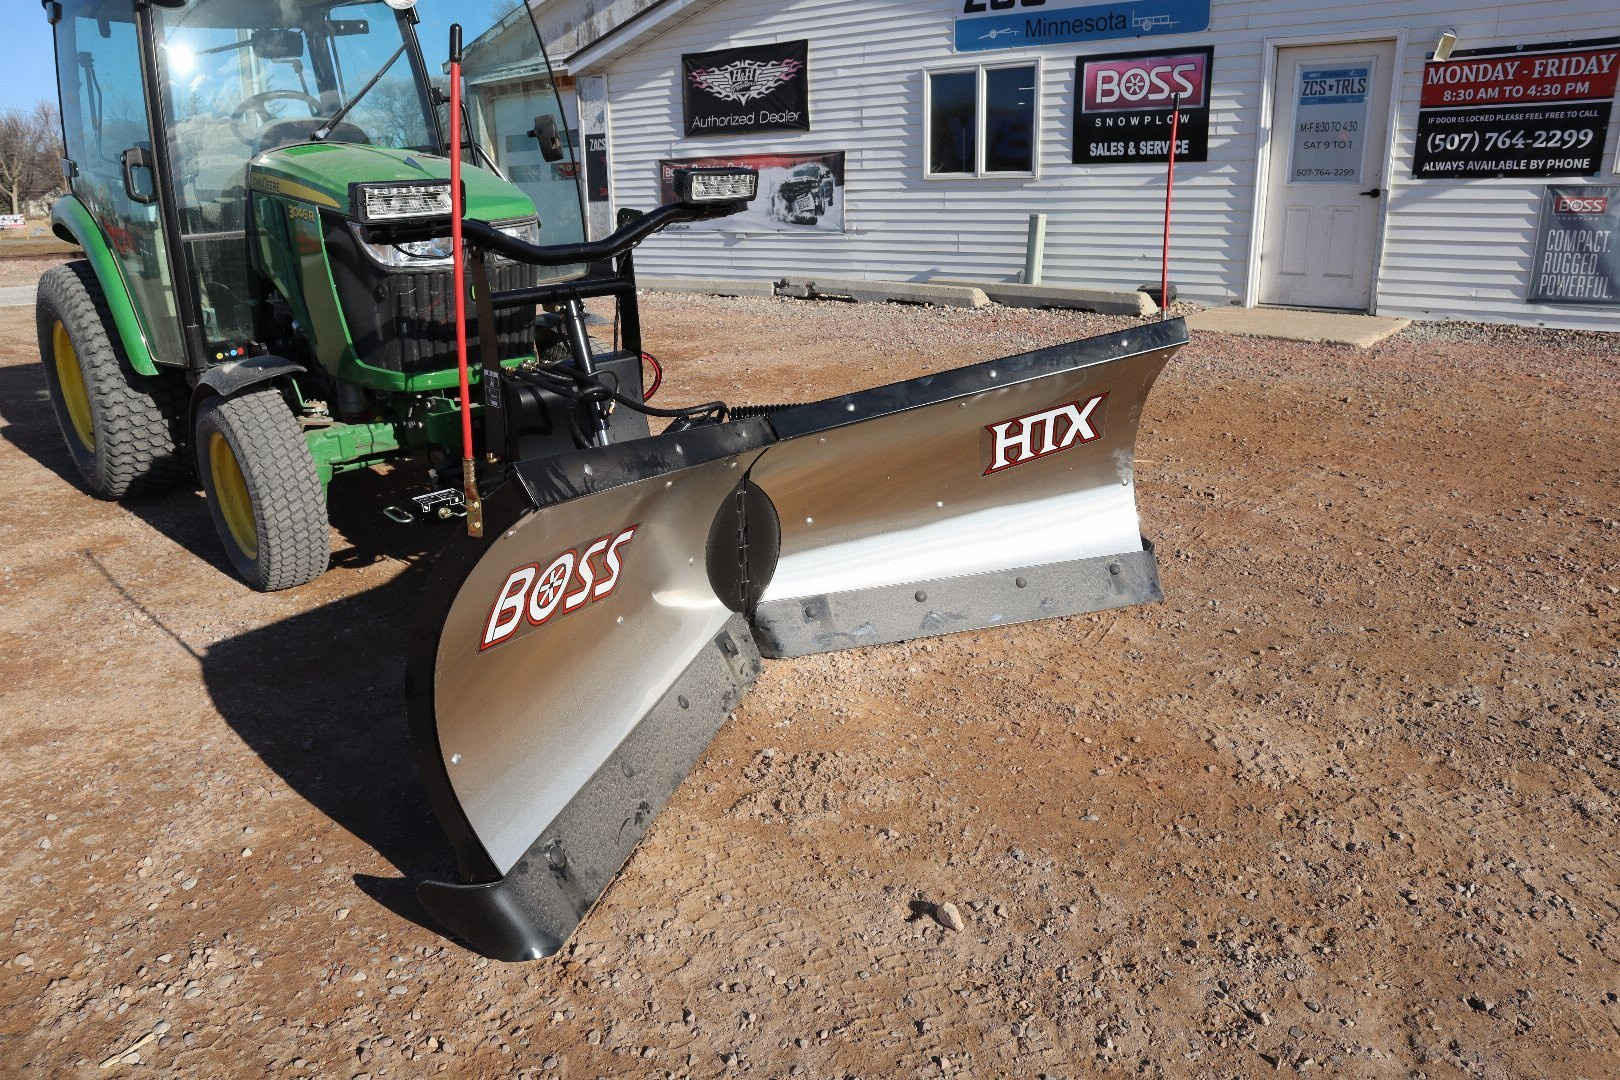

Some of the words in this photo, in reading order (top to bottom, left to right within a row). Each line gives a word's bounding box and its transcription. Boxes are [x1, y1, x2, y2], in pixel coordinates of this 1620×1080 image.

[1025, 12, 1127, 38] Minnesota
[1426, 61, 1520, 85] MONDAY
[1532, 53, 1617, 79] FRIDAY
[1095, 64, 1196, 103] BOSS
[1302, 80, 1327, 96] ZCS
[1335, 78, 1366, 95] TRLS
[1443, 89, 1474, 101] 8:30
[1476, 87, 1500, 99] AM
[1503, 85, 1524, 98] TO
[1527, 83, 1561, 97] 4:30
[1564, 81, 1590, 94] PM
[692, 112, 755, 129] Authorized
[759, 110, 801, 123] Dealer
[1466, 114, 1495, 122] LOCKED
[1496, 113, 1524, 121] PLEASE
[1525, 112, 1544, 120] FEEL
[1545, 111, 1565, 119] FREE
[1566, 110, 1577, 118] TO
[1300, 122, 1314, 133] M-F
[1332, 122, 1341, 132] TO
[1342, 121, 1358, 132] 4:30
[1090, 141, 1124, 157] SALES
[1128, 141, 1136, 155] &
[1139, 140, 1189, 155] SERVCE
[1303, 141, 1322, 150] SAT
[1324, 141, 1330, 149] 9
[1333, 140, 1346, 149] TO
[1427, 130, 1480, 154] (507)
[1484, 128, 1594, 151] 764-2299
[1296, 168, 1355, 177] 507-764-2299
[1422, 161, 1465, 172] ALWAYS
[1466, 159, 1527, 170] AVAILABLE
[1529, 159, 1544, 170] BY
[1547, 158, 1591, 169] PHONE
[1558, 199, 1604, 212] BOSS
[1546, 229, 1612, 253] COMPACT.
[1542, 252, 1600, 275] RUGGED.
[1539, 274, 1613, 299] POWERFUL.
[985, 393, 1108, 474] HTX
[481, 525, 637, 648] BOSS
